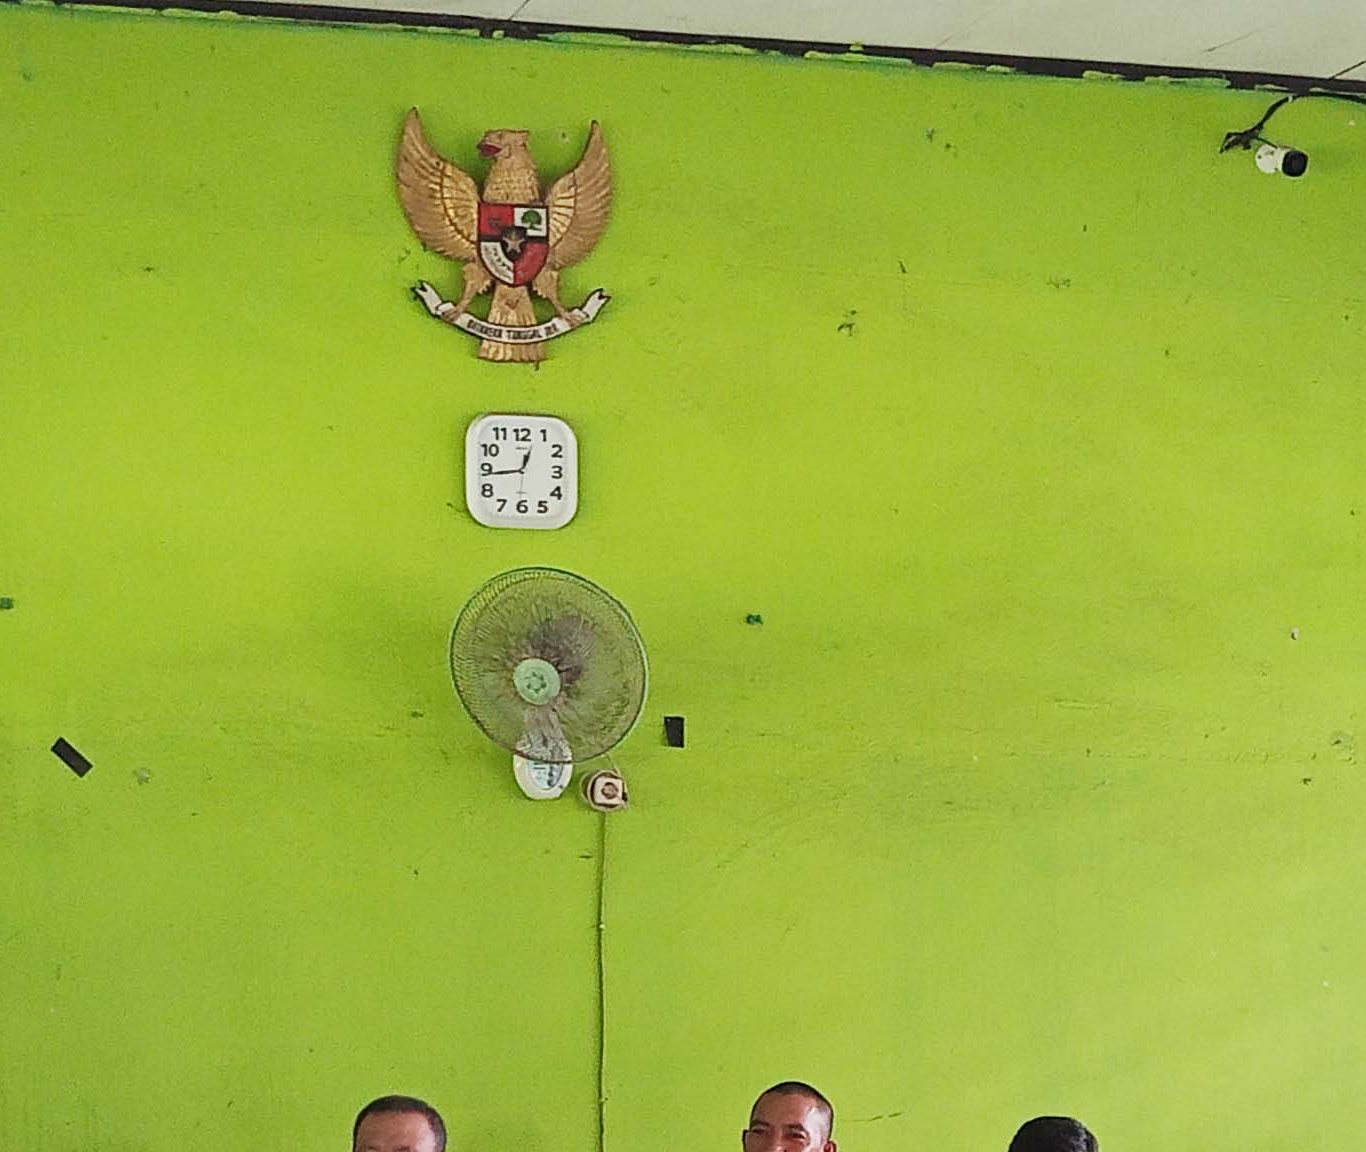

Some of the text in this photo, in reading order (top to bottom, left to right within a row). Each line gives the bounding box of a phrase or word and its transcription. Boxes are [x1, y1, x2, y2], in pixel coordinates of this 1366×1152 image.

[492, 427, 547, 442] 11 12 1
[480, 443, 563, 458] 10 2
[480, 463, 563, 479] 9 3
[481, 483, 563, 500] 8 4
[496, 499, 548, 514] 7 6 5
